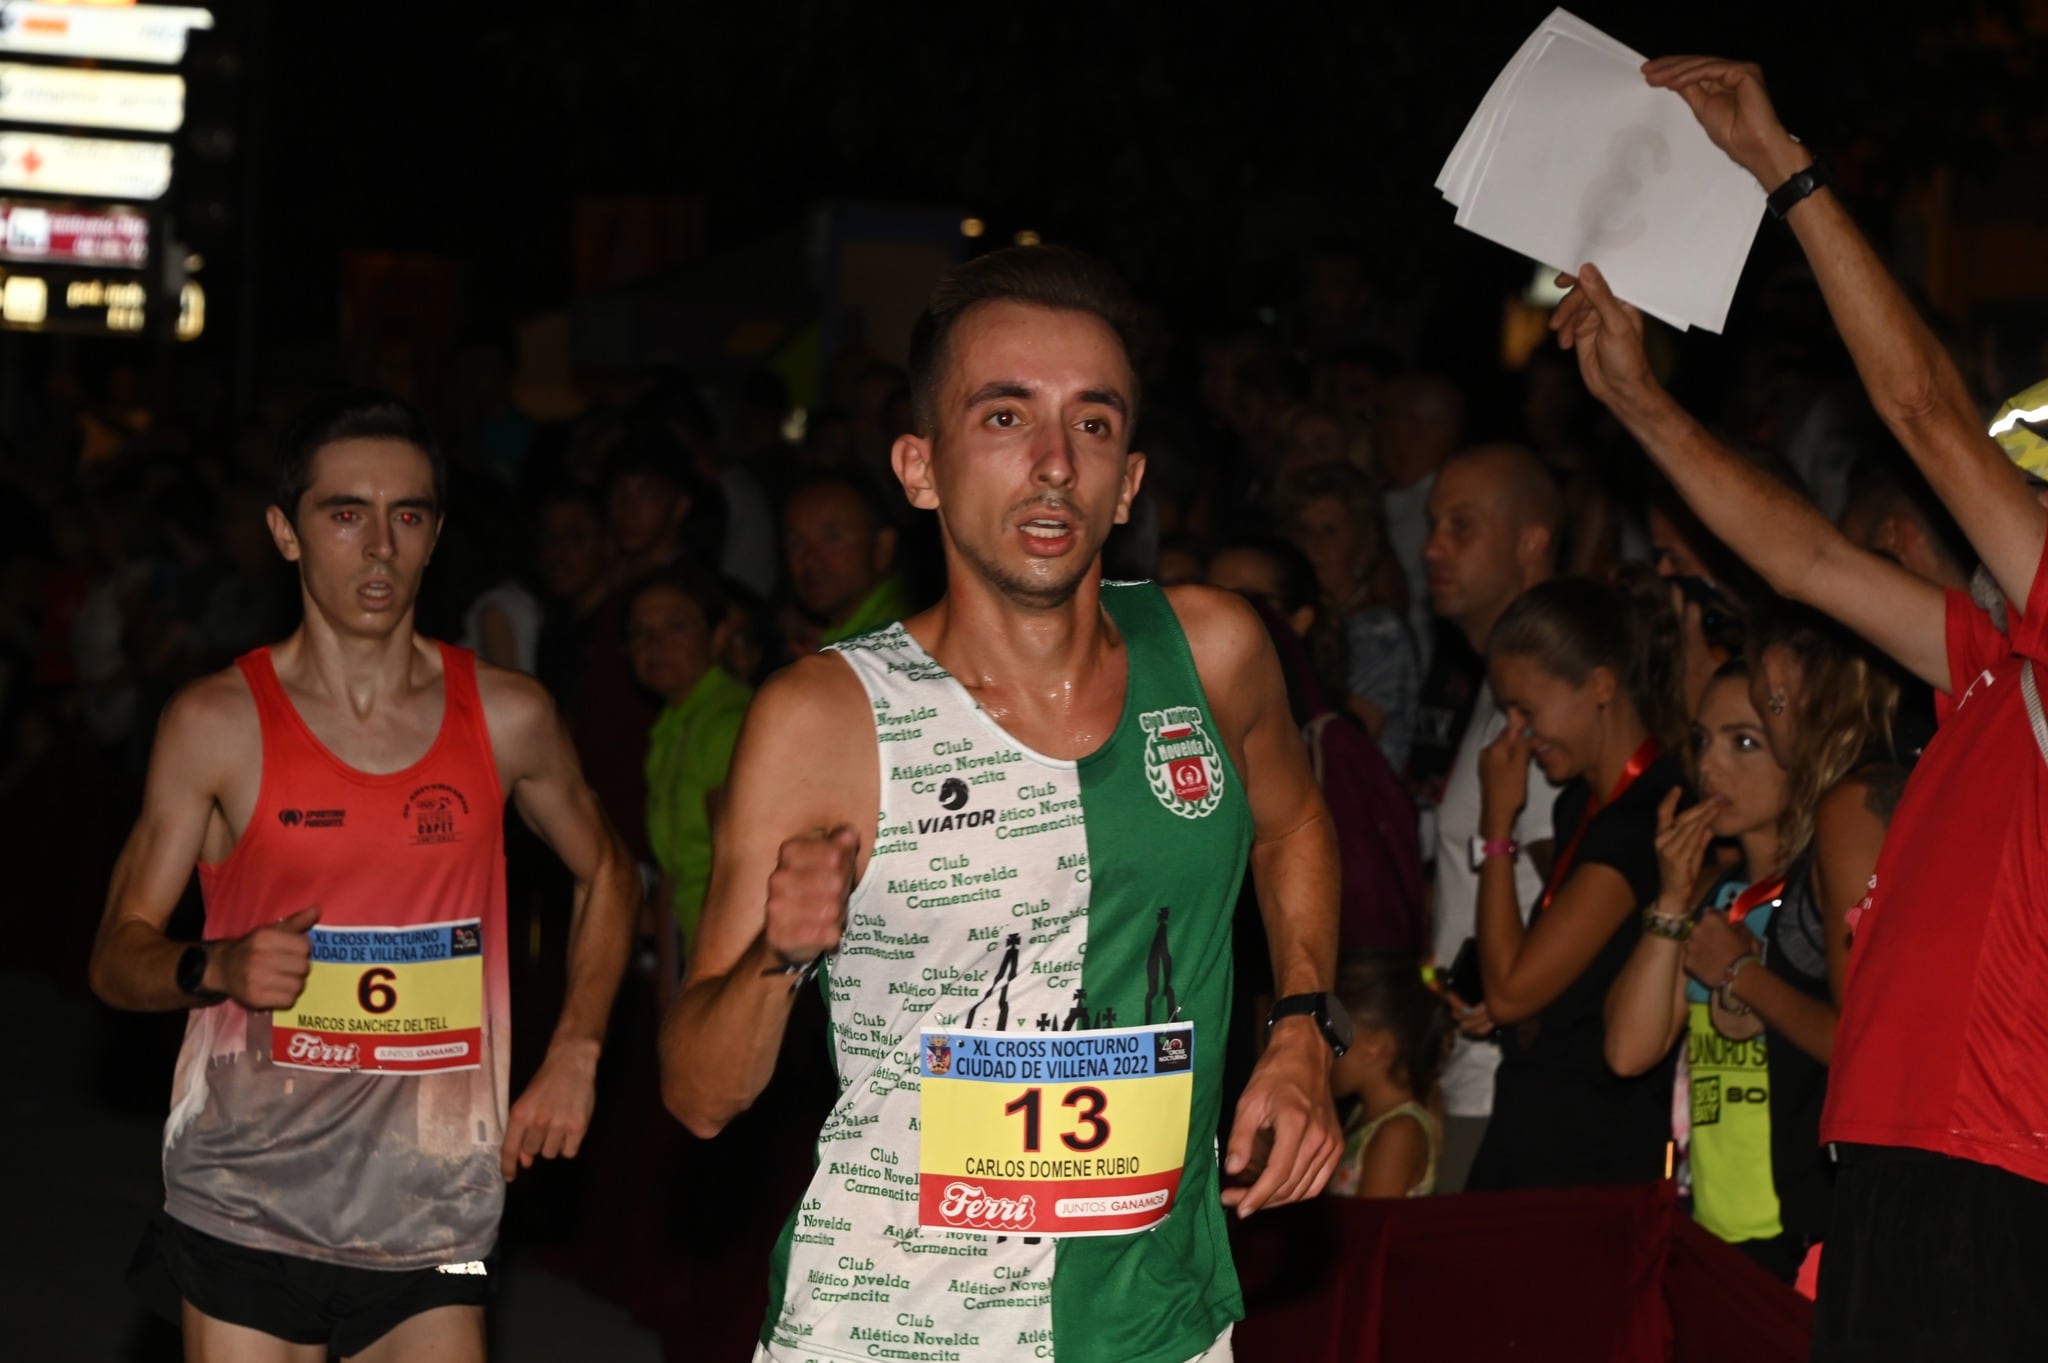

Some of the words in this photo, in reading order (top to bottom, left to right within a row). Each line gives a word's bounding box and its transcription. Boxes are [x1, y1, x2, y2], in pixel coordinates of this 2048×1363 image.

[877, 707, 938, 726] Novelda
[933, 738, 973, 756] Club
[1157, 740, 1205, 761] Novelda
[891, 764, 952, 781] Atlético
[955, 751, 1022, 771] Novelda
[1017, 782, 1057, 800] Club
[918, 809, 995, 835] VIATOR
[929, 854, 970, 872] Club
[887, 877, 946, 894] Atlético
[952, 866, 1018, 887] Novelda
[906, 888, 1001, 909] Carmencita
[1012, 899, 1051, 917] Club
[853, 913, 886, 928] Club
[315, 932, 330, 945] XL
[332, 932, 370, 945] CROSS
[373, 929, 439, 946] NOCTURNO
[873, 929, 930, 945] Novelda
[351, 947, 366, 960] DE
[369, 946, 417, 961] VILLENA
[420, 943, 446, 959] 2022
[922, 966, 960, 981] Club
[357, 967, 397, 1014] 6
[297, 1014, 345, 1031] MARCOS
[348, 1018, 400, 1032] SANCHEZ
[403, 1016, 448, 1032] DELTELL
[853, 1012, 886, 1027] Club
[288, 1032, 358, 1065] Ferri
[973, 1039, 990, 1057] XL
[996, 1040, 1046, 1058] CROSS
[1052, 1036, 1139, 1057] NOCTURNO
[956, 1057, 1018, 1077] CIUDAD
[1021, 1060, 1042, 1079] DE
[1046, 1059, 1108, 1078] VILLENA
[1113, 1055, 1149, 1075] 2022
[1004, 1085, 1111, 1153] 13
[870, 1147, 899, 1165] Club
[828, 1162, 881, 1179] Atlético
[884, 1167, 920, 1185] Novel
[965, 1157, 1025, 1178] CARLOS
[1030, 1160, 1091, 1178] DOMENE
[1096, 1156, 1140, 1175] RUBIO
[939, 1182, 1035, 1226] Ferri
[1061, 1201, 1106, 1214] JUNTOS
[1111, 1193, 1165, 1212] GANAMOS
[803, 1214, 852, 1231] Novelda
[838, 1256, 875, 1271] Club
[808, 1269, 849, 1288] Atlético
[993, 1266, 1032, 1280] Club
[948, 1279, 1006, 1296] Atlético
[896, 1312, 934, 1328] Club
[850, 1327, 909, 1344] Atlético
[914, 1332, 980, 1346] Novelda
[867, 1344, 960, 1362] Carmencita
